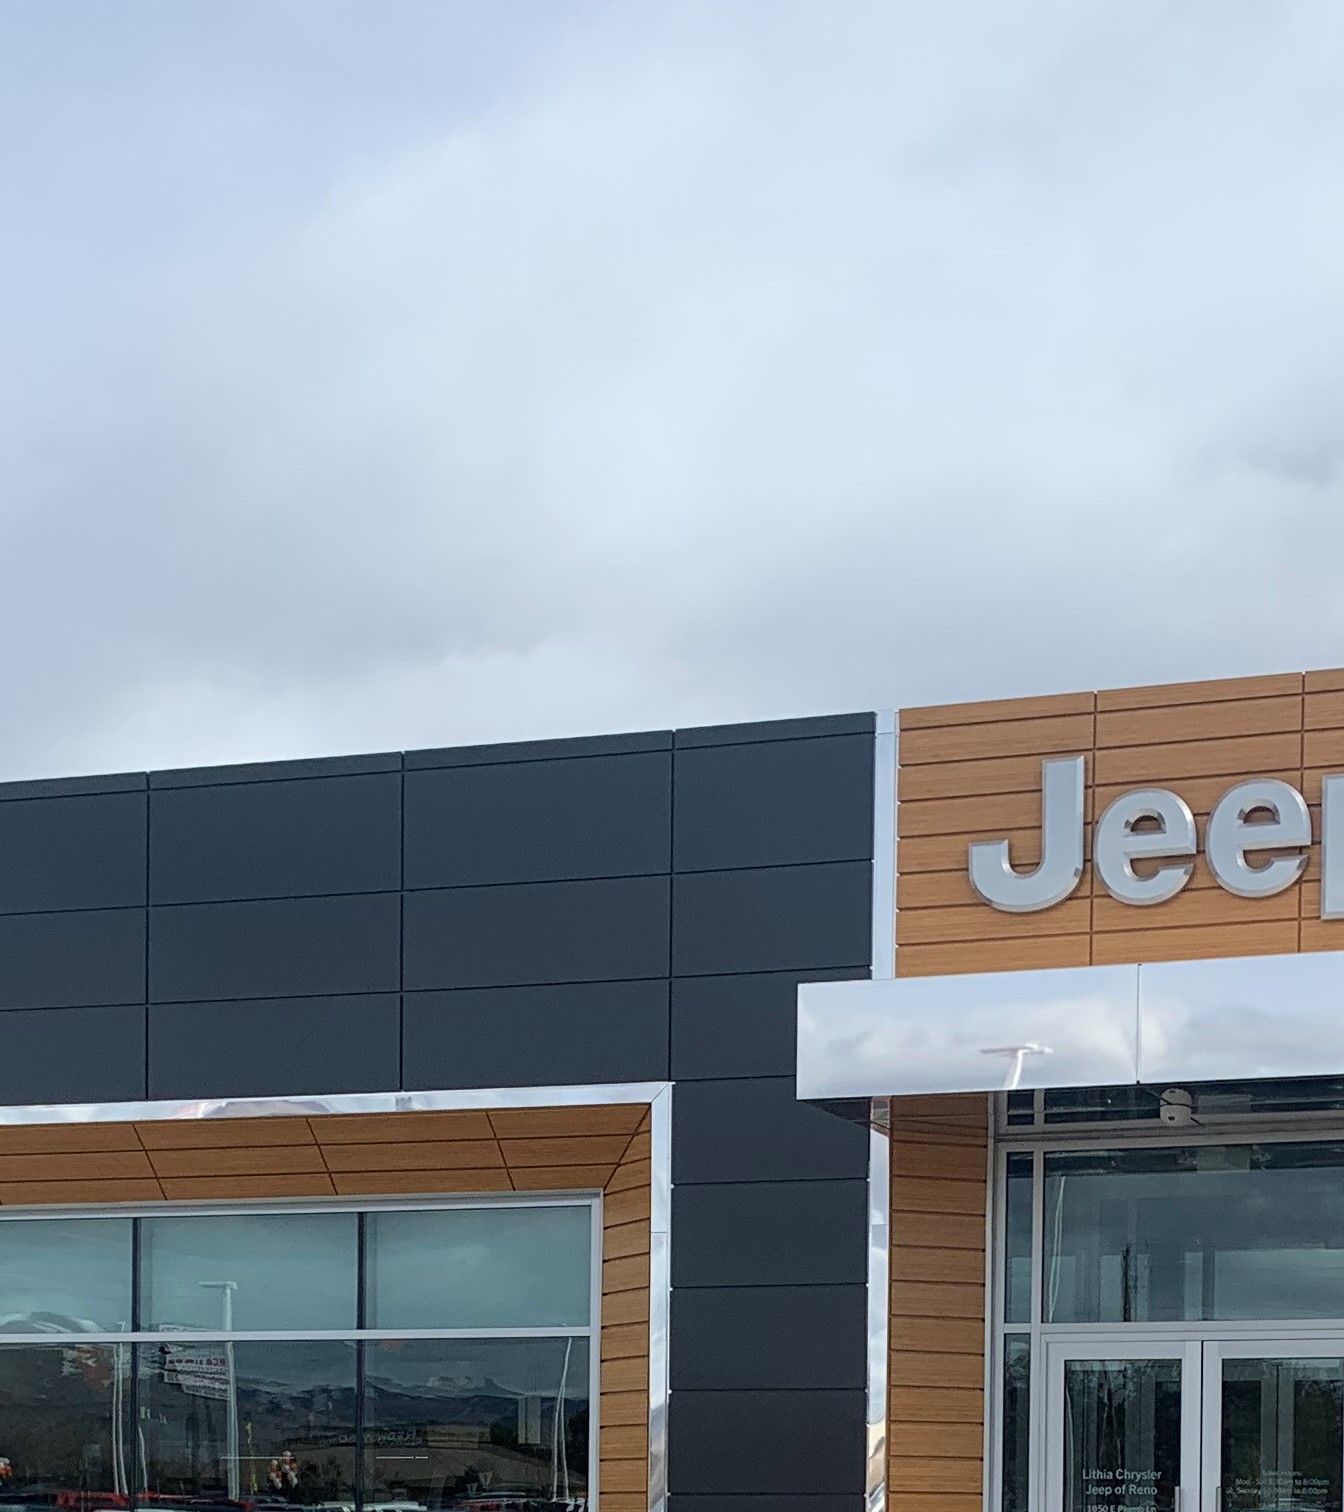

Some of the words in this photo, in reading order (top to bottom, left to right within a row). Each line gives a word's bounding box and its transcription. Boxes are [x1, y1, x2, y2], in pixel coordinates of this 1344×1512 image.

[1082, 1468, 1114, 1480] Lithia
[1115, 1468, 1162, 1482] Chrysler
[1085, 1483, 1113, 1497] Jeep
[1114, 1483, 1126, 1495] of
[1128, 1483, 1158, 1495] Reno
